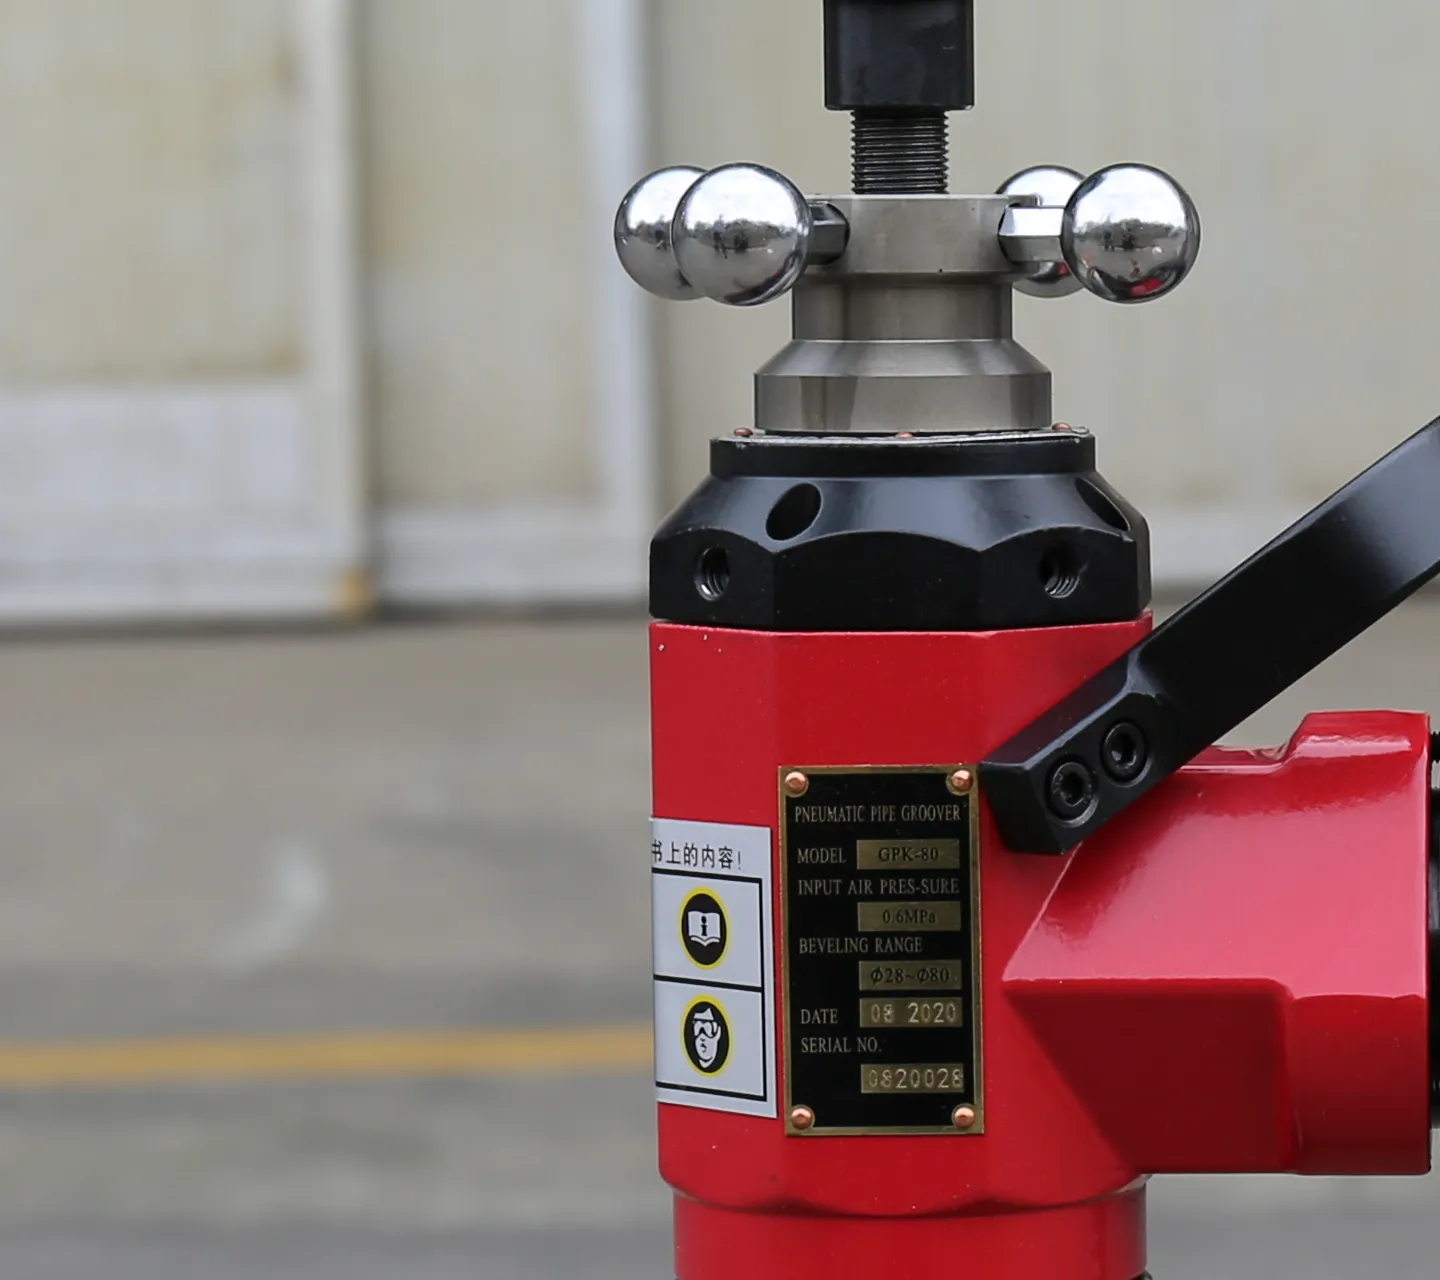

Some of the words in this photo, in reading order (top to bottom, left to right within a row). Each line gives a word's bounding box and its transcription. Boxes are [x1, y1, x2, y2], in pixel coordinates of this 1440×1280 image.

[794, 805, 866, 822] PNEUMATIC
[870, 805, 897, 822] PIPE
[901, 804, 961, 821] GROOVER
[797, 847, 847, 864] MODEL
[878, 846, 939, 862] GPK-80
[798, 879, 842, 895] INPUT
[847, 879, 874, 895] AIR
[879, 878, 960, 895] PRES-SURE
[882, 909, 937, 924] 0.6MPa
[799, 937, 869, 954] BEVELING
[875, 936, 924, 953] RANGE
[800, 1008, 839, 1025] DATE
[870, 1003, 894, 1023] 08
[907, 1002, 957, 1023] 2020
[800, 1037, 852, 1053] SERIAL
[857, 1036, 883, 1053] NO.
[868, 1068, 964, 1088] 0820028
